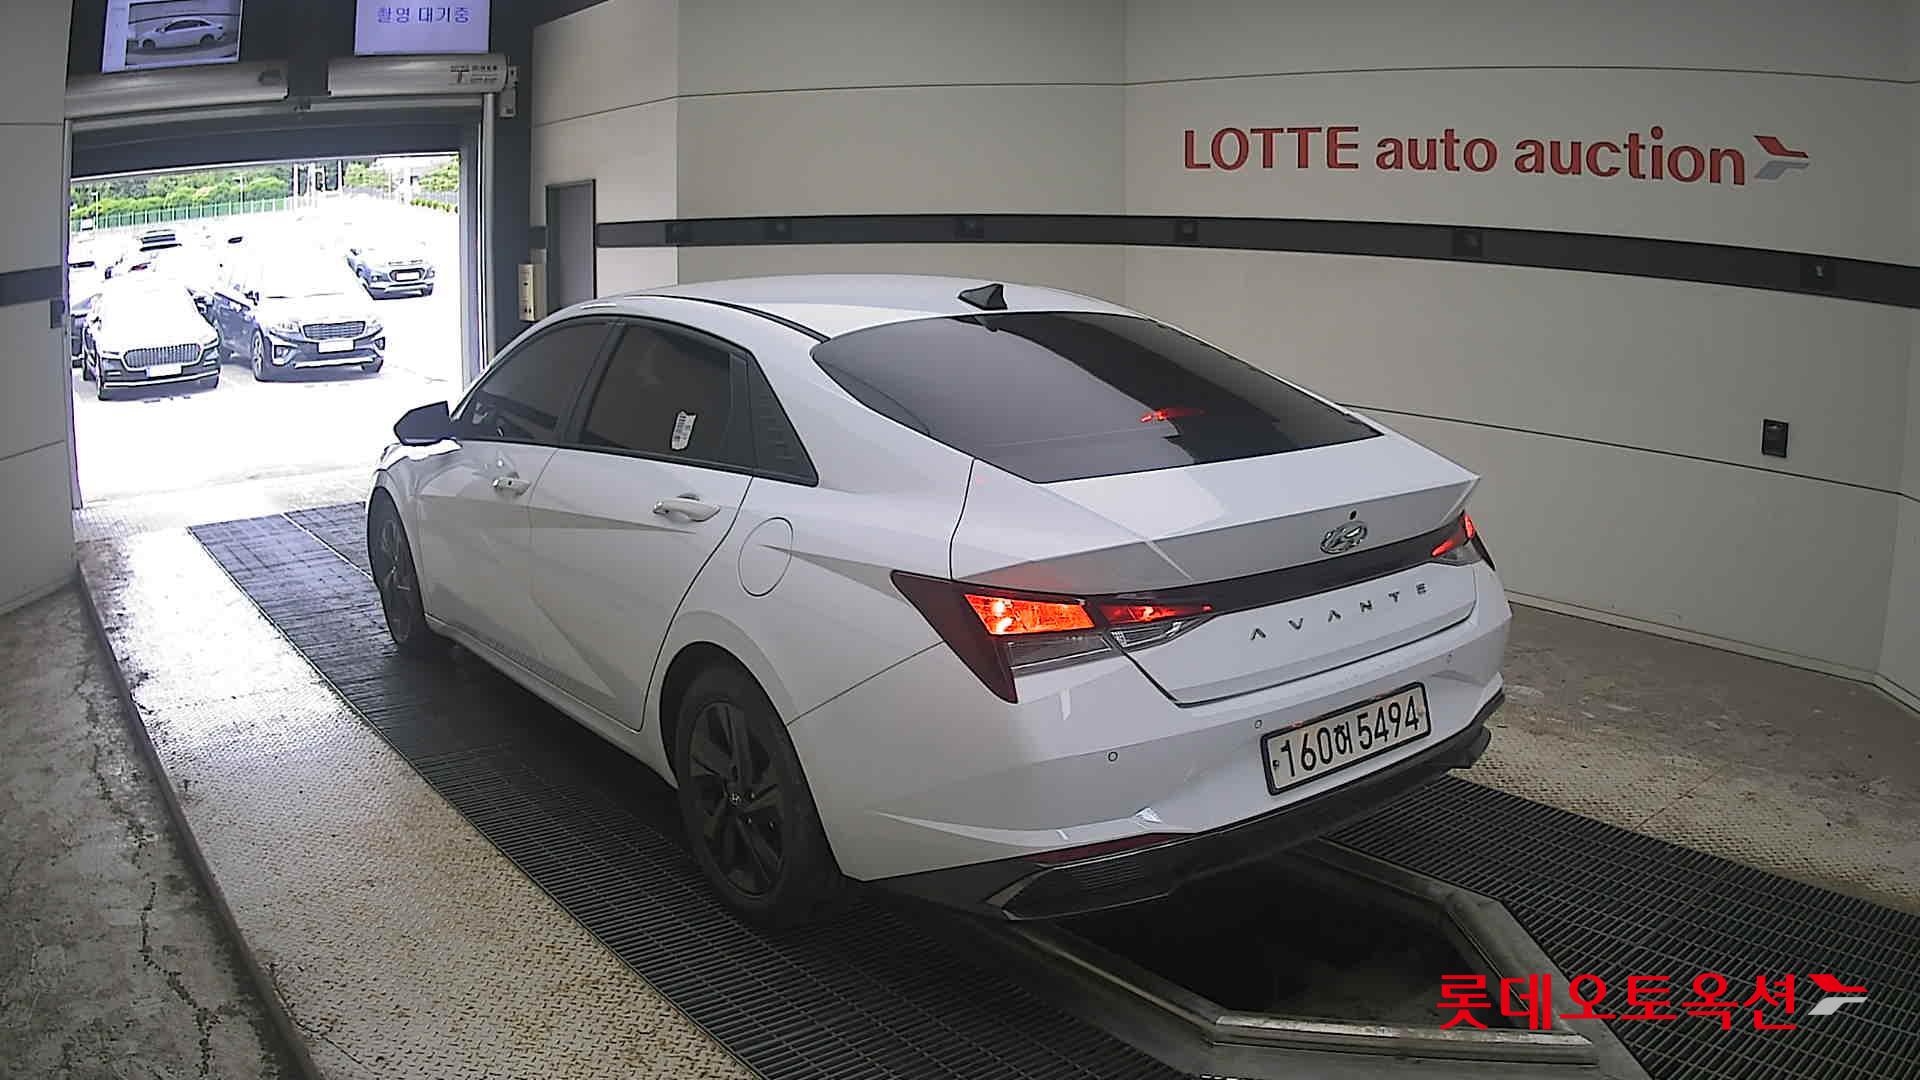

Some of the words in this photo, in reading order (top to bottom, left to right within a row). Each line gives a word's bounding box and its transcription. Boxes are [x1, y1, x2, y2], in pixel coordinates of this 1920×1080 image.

[418, 7, 469, 24] 대기중
[1184, 126, 1359, 171] LOTTE
[1375, 128, 1498, 173] auto
[1515, 126, 1746, 186] auction
[1250, 582, 1428, 641] AVANTE
